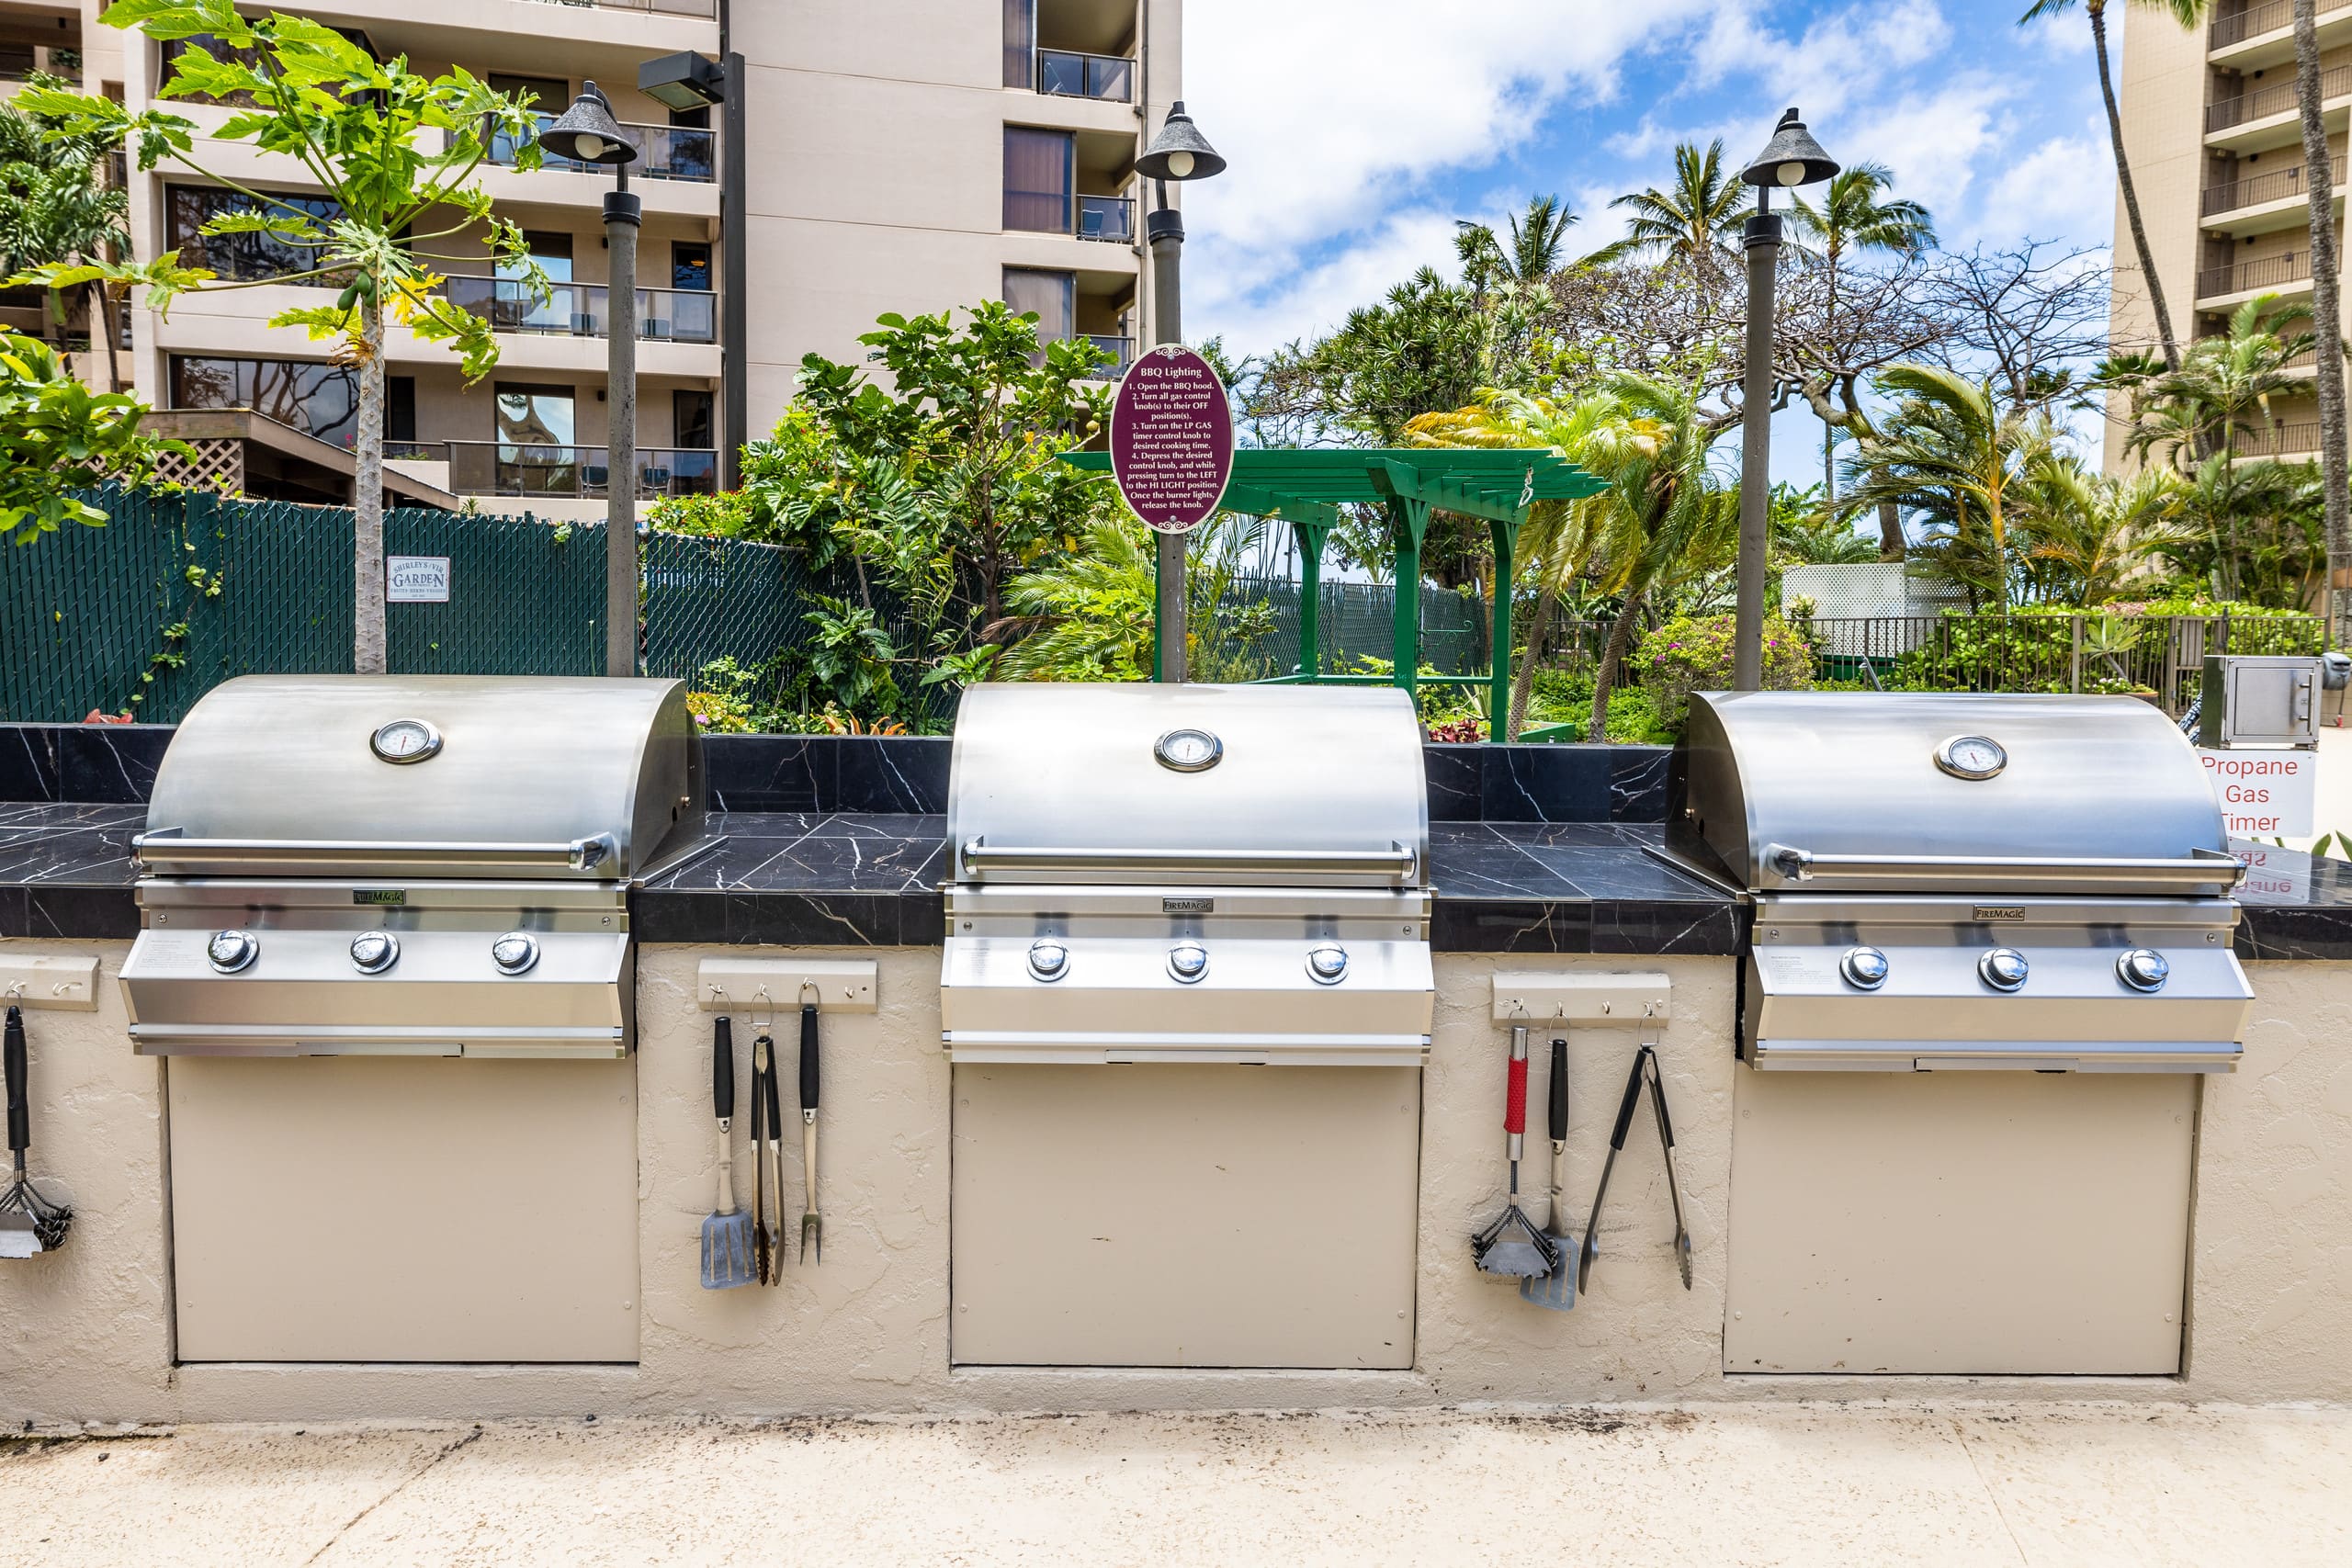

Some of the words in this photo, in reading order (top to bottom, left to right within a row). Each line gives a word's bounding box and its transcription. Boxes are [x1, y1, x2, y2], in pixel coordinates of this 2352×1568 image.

[1141, 367, 1162, 378] BBQ
[1165, 367, 1202, 378] Lighting
[1137, 383, 1158, 391] Open
[1151, 412, 1192, 421] position(s).
[1155, 431, 1181, 439] control
[1183, 431, 1201, 439] knob
[1162, 442, 1190, 450] cooking
[1127, 472, 1157, 480] pressing
[1188, 481, 1219, 490] position.
[1193, 491, 1215, 500] lights,
[392, 574, 445, 587] GARDEN
[2201, 757, 2298, 779] Propane
[2225, 784, 2269, 803] Gas
